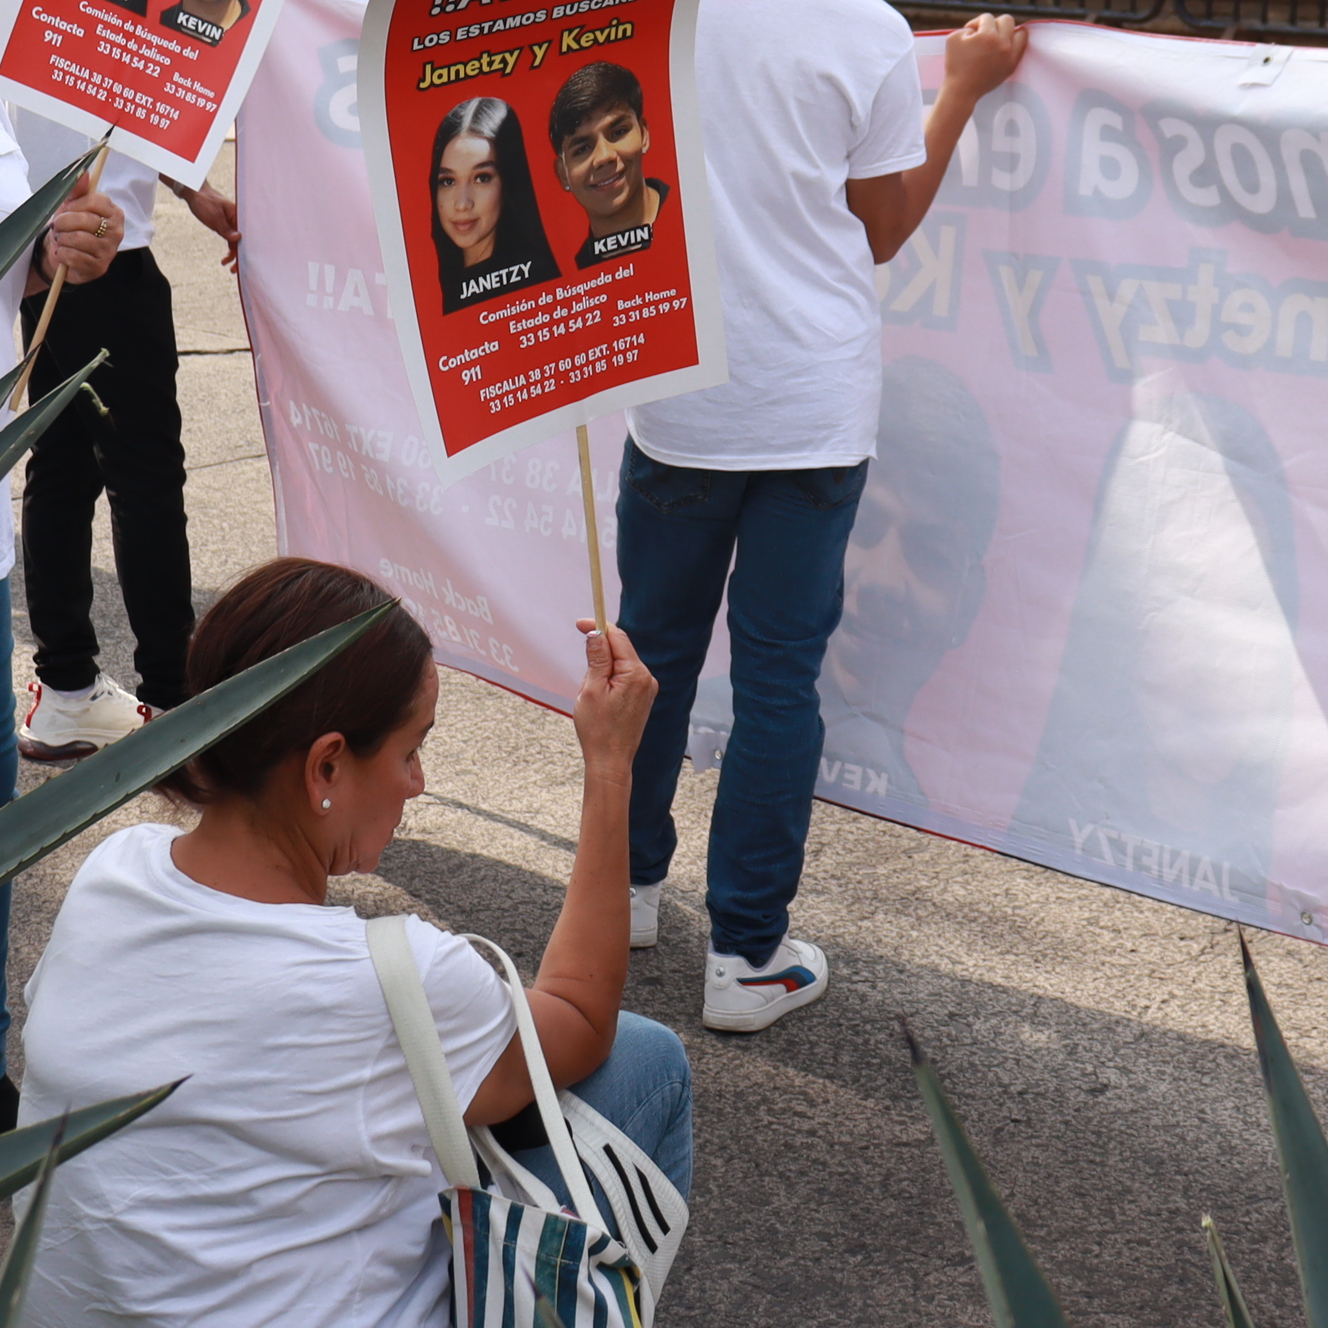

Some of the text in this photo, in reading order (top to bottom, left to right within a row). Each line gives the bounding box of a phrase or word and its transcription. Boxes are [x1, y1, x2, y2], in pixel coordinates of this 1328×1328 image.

[31, 6, 85, 37] Contacta
[43, 30, 63, 48] 911
[78, 0, 199, 60] Comisión de Búsqueda del
[176, 12, 223, 40] KEVIN
[412, 30, 451, 51] LOS
[456, 9, 547, 41] ESTAMOS
[95, 24, 171, 65] Estado de Jalisco
[97, 41, 161, 77] 33 15 14 54 22
[418, 18, 634, 91] Janetzy y Kevin
[49, 54, 180, 120] FISCALIA 38 37 60 60 EXT. 16714
[51, 69, 63, 81] 33
[64, 75, 74, 87] 15
[76, 80, 86, 92] 14
[87, 85, 97, 97] 54
[97, 89, 107, 101] 22
[113, 97, 124, 109] 33
[125, 102, 135, 115] 31
[136, 107, 146, 120] 85
[149, 112, 159, 125] 19
[160, 117, 170, 130] 97
[163, 82, 217, 113] 33 31 85 19 97
[172, 72, 215, 98] Back Home
[593, 226, 649, 255] KEVIN
[459, 261, 532, 299] JANETZY
[479, 263, 634, 325] Comisión de Búsqueda del
[617, 287, 677, 311] Back Home
[509, 292, 608, 335] Estado de Jalisco
[519, 310, 602, 349] 33 15 14 54 22
[612, 297, 688, 327] 33 31 85 19 97
[438, 339, 500, 372] Contacta
[479, 333, 645, 402] FISCALIA 38 37 60 60 EXT. 16714
[461, 365, 482, 386] 911
[489, 400, 501, 414] 33
[503, 395, 515, 409] 15
[516, 389, 529, 403] 14
[530, 383, 542, 398] 54
[544, 378, 556, 393] 22
[569, 370, 582, 384] 33
[583, 364, 594, 379] 31
[595, 360, 607, 373] 85
[612, 354, 624, 368] 19
[626, 349, 639, 363] 97
